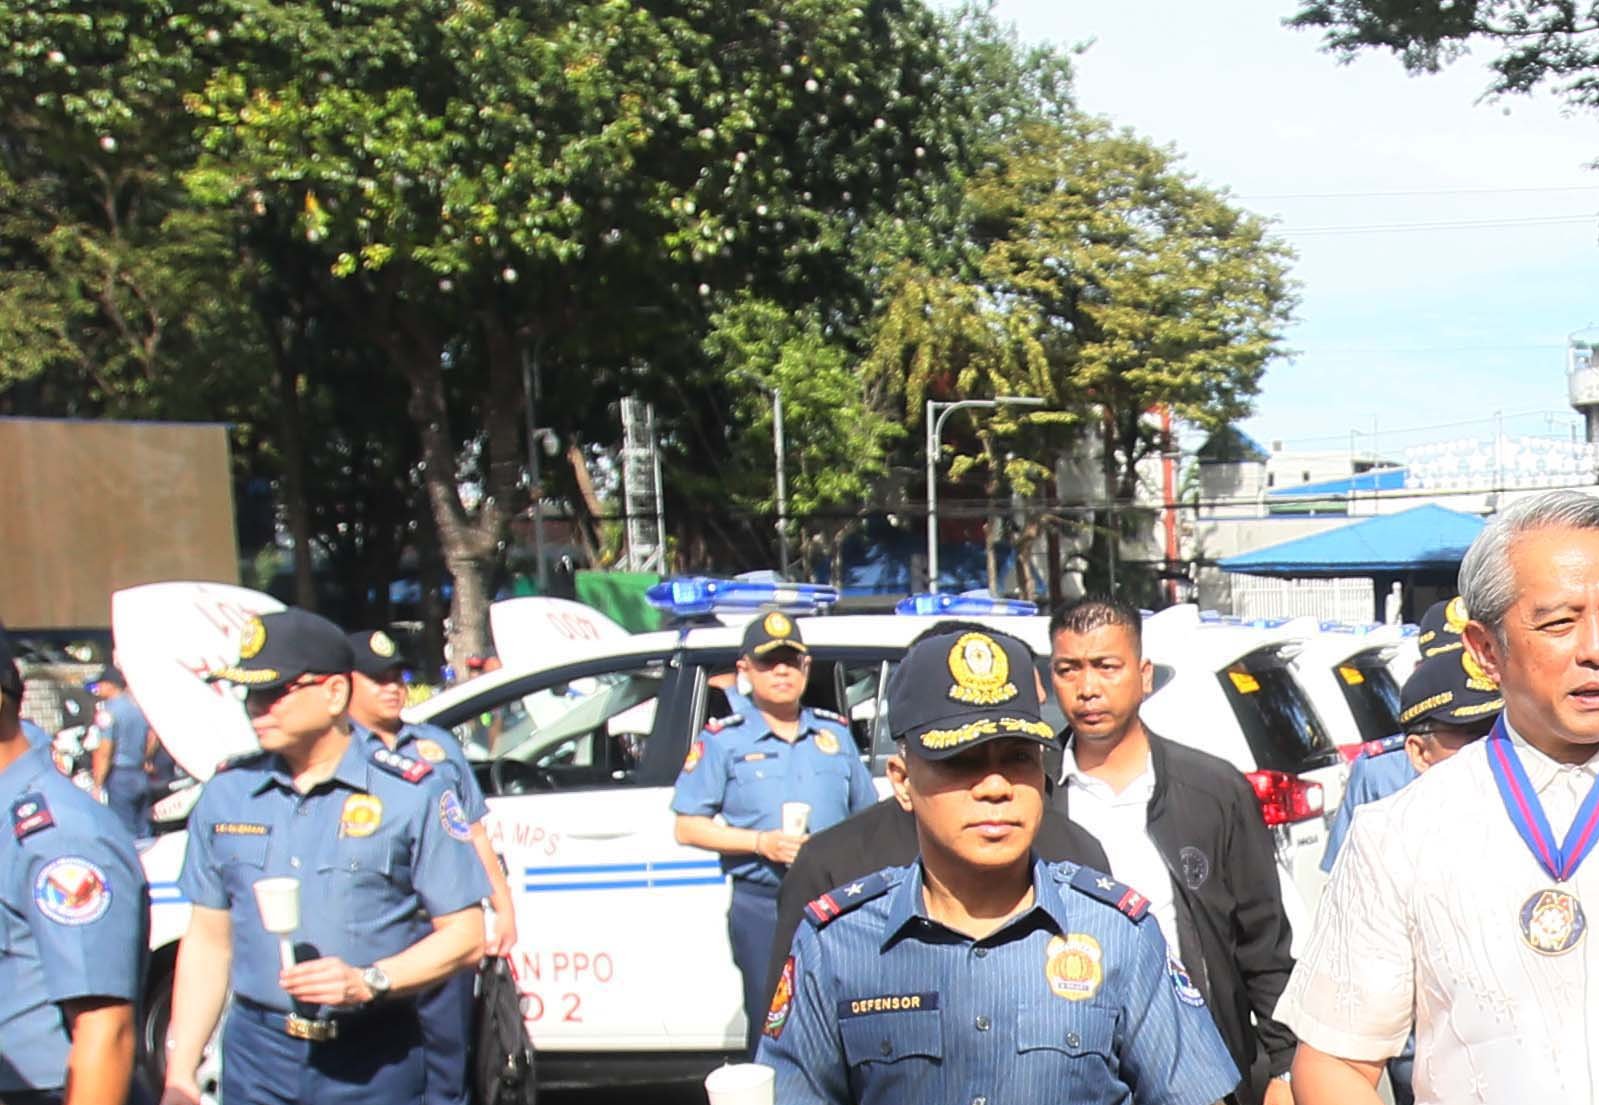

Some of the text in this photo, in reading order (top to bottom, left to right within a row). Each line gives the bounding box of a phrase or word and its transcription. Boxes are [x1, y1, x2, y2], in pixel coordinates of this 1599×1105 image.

[553, 952, 613, 983] PPO
[561, 992, 583, 1023] 2
[851, 996, 921, 1014] DEFENSOR
